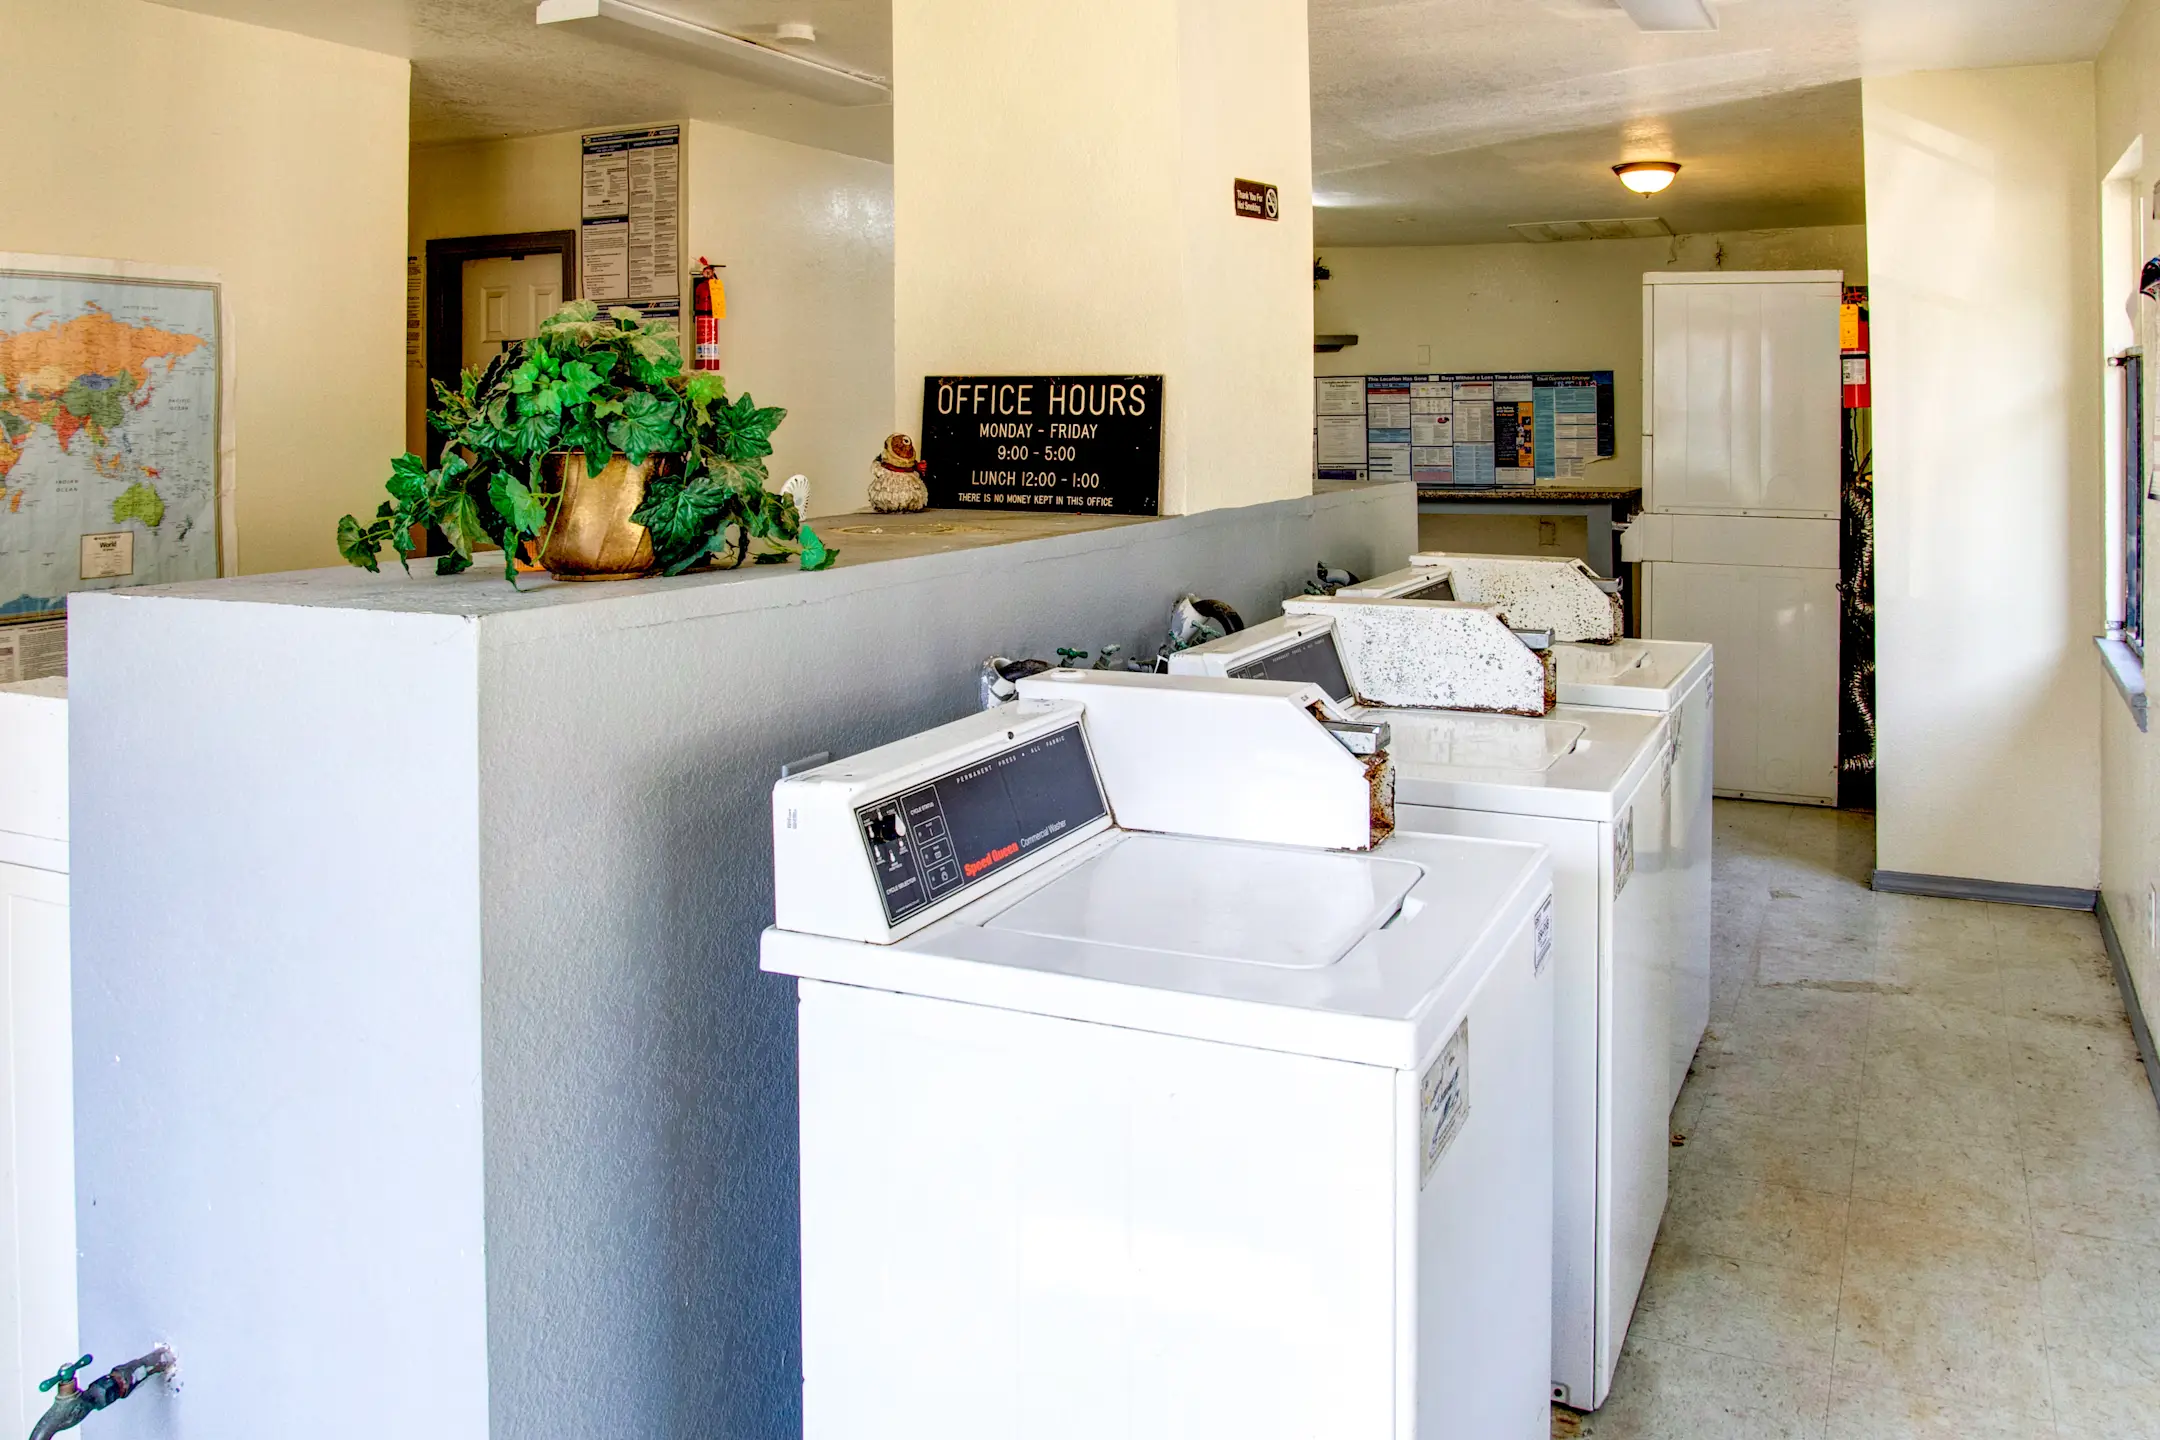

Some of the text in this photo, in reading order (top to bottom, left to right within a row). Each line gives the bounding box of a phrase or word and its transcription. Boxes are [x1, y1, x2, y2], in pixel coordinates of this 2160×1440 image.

[938, 384, 1146, 416] OFFICE HOURS
[980, 423, 1033, 438] MONDAY
[1050, 424, 1098, 438] FRIDAY
[998, 446, 1028, 460] 9:00
[1044, 446, 1076, 461] 5:00
[972, 470, 1016, 486] LUNCH
[1022, 471, 1056, 487] 12:00
[1072, 472, 1100, 488] 1:00
[958, 493, 1114, 507] THERE IS NO MONEY KEPT IN THIS OFFICE
[956, 736, 1066, 784] PERMANENT PRESS ALL FABRIC
[910, 802, 935, 816] CYCLE STATUS
[964, 819, 1066, 876] Speed Queen Commercial Washer
[886, 876, 916, 895] CYCLE SELECTOR
